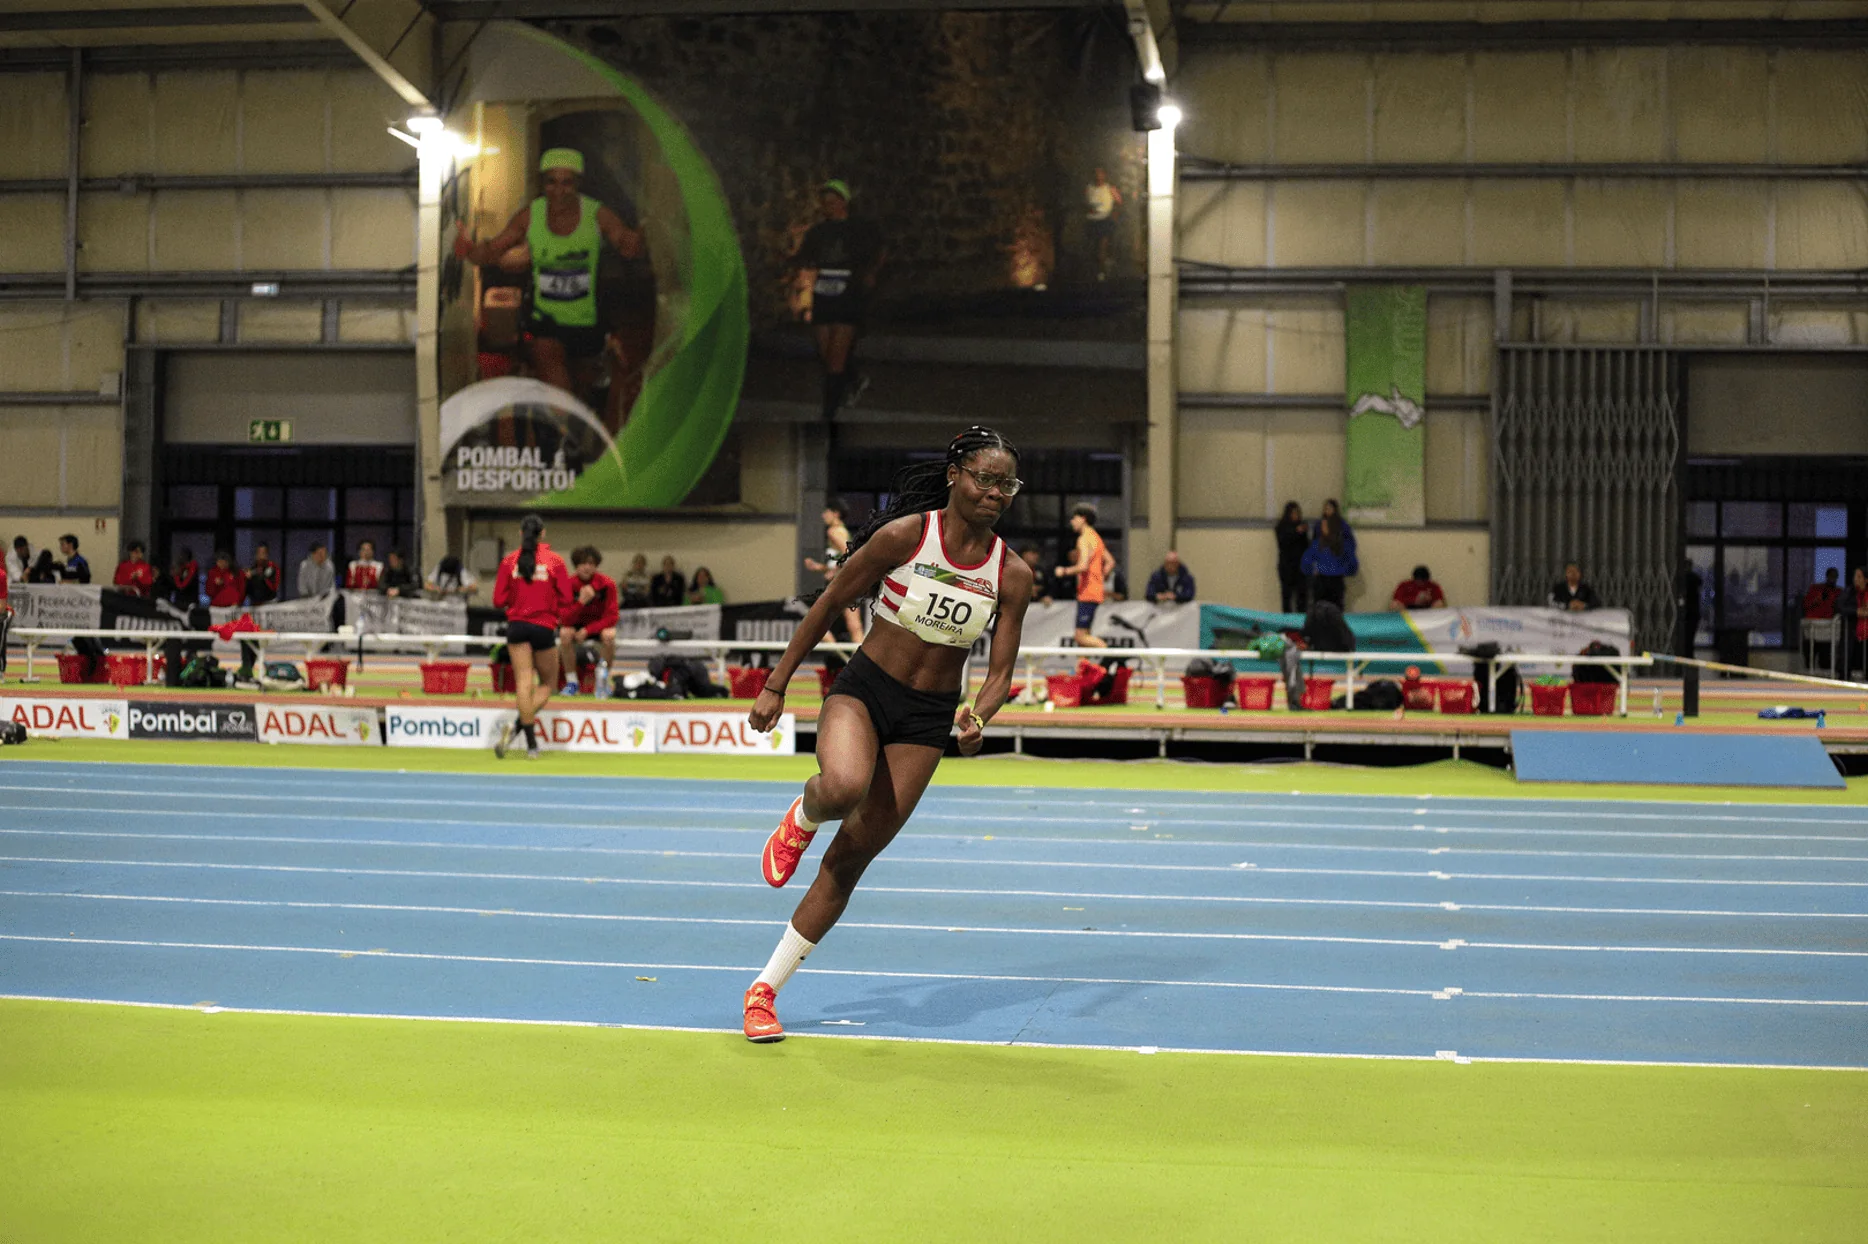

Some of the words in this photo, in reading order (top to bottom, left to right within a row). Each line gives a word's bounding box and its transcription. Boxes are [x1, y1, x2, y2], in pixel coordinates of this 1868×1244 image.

[457, 446, 547, 468] POMBAL
[457, 469, 576, 491] DESPORTO!
[926, 593, 972, 625] 150
[914, 614, 963, 636] MOREIRA
[12, 704, 96, 731] ADAL
[129, 708, 217, 733] Pombal
[263, 710, 347, 738] ADAL
[389, 714, 481, 738] Pombal
[663, 719, 757, 747] ADAL
